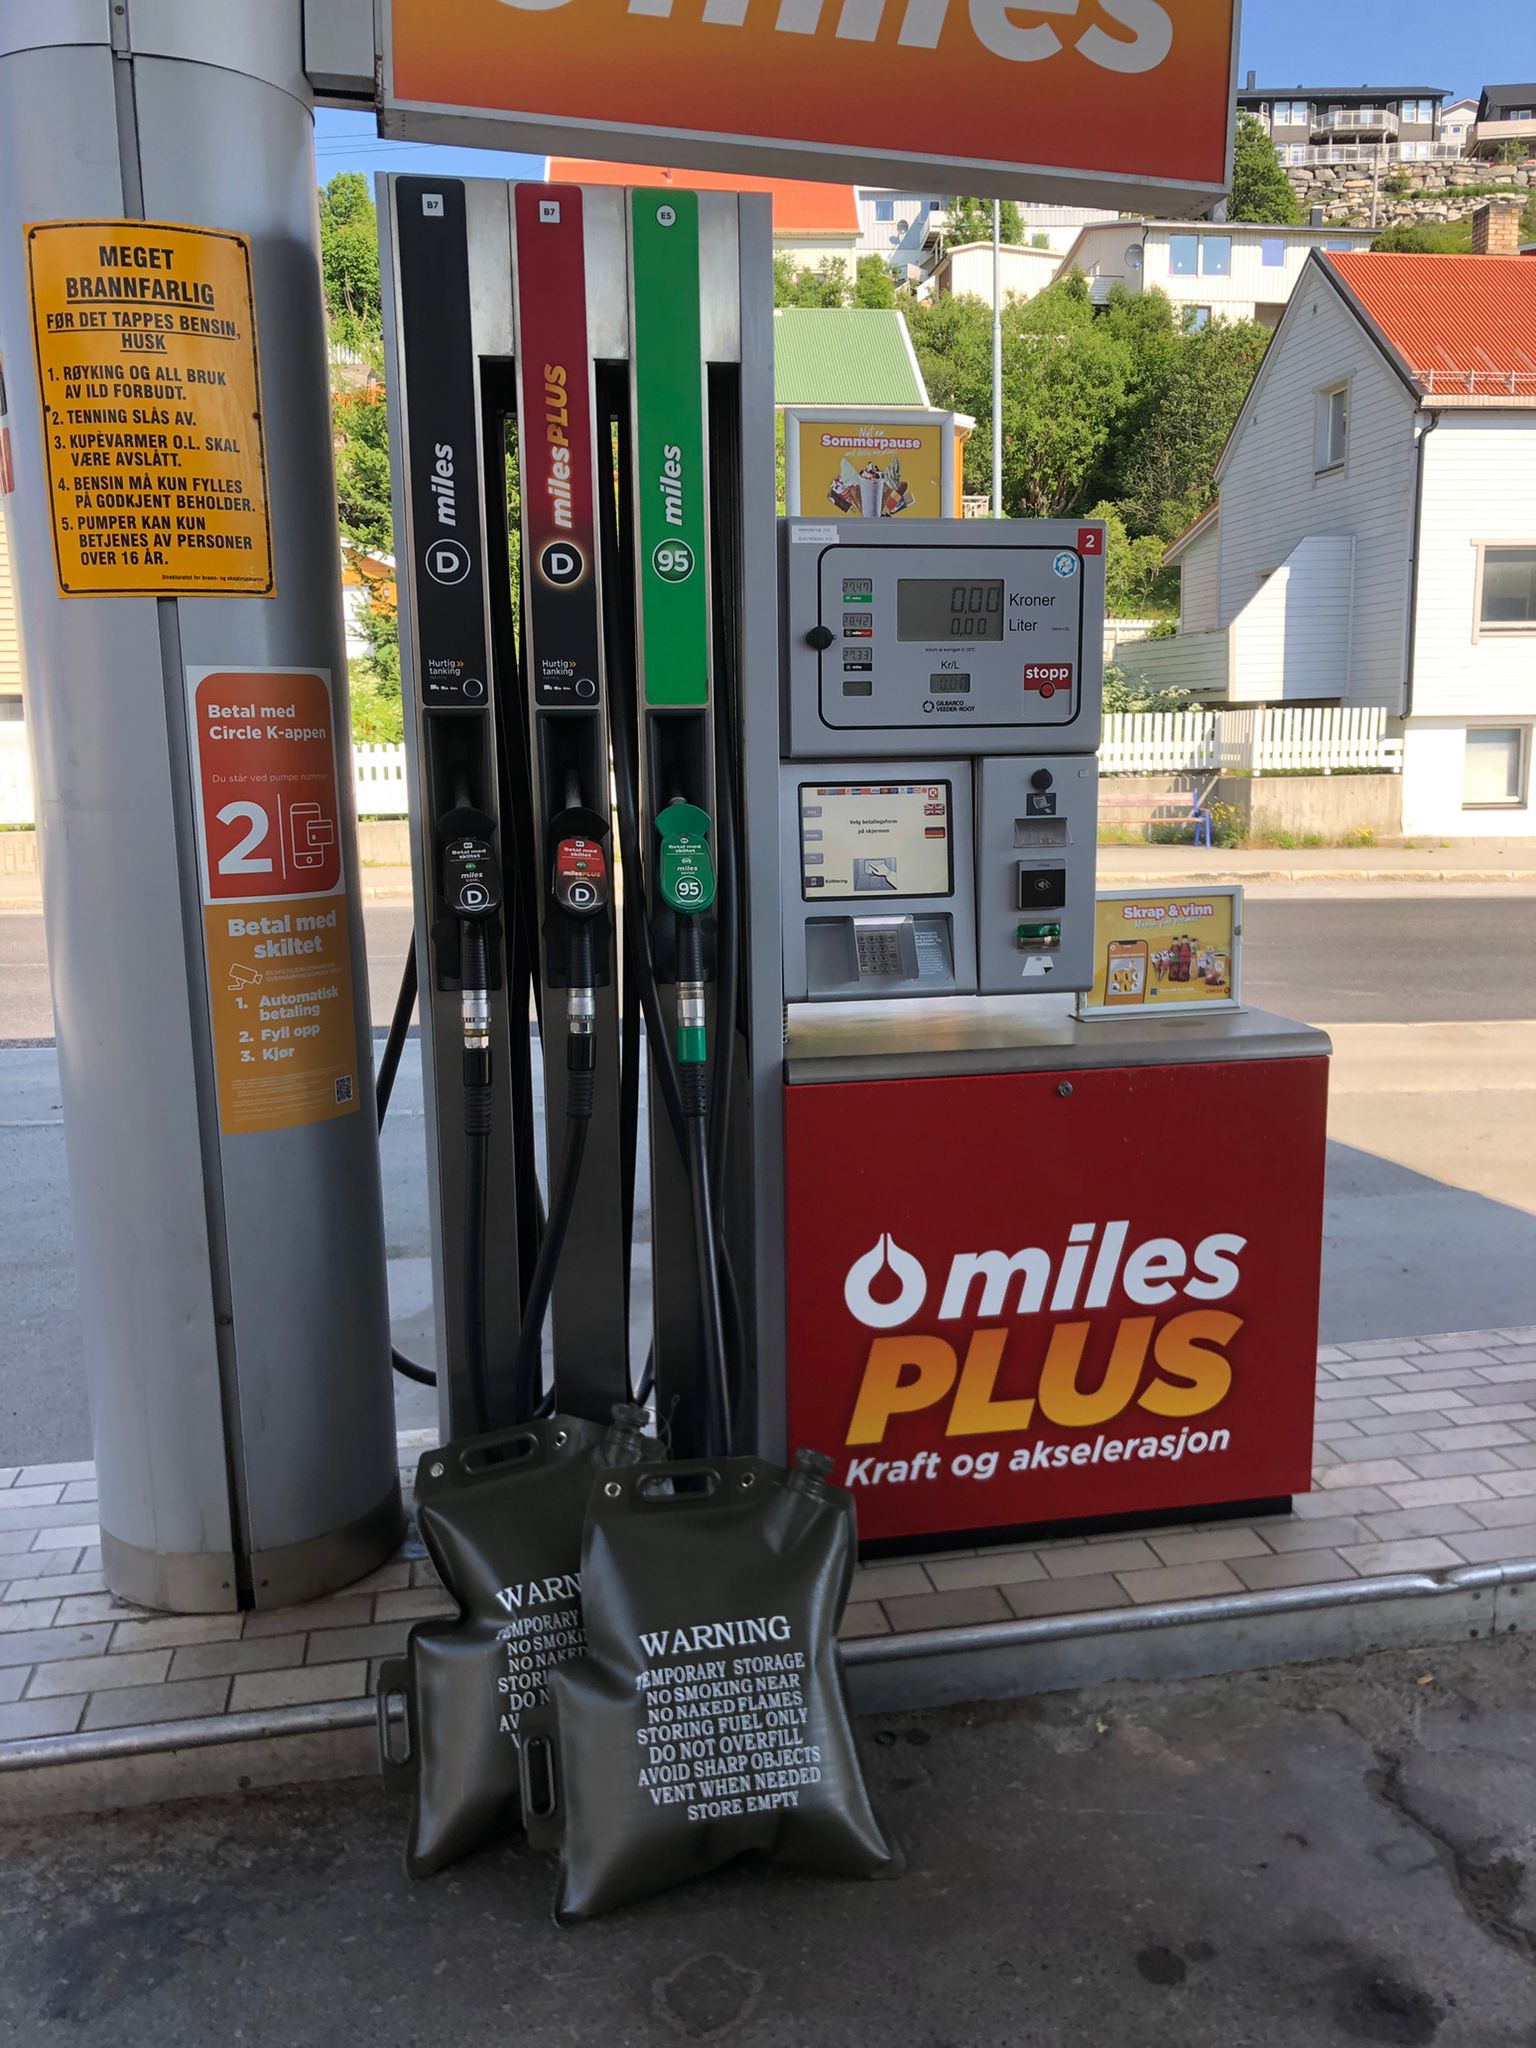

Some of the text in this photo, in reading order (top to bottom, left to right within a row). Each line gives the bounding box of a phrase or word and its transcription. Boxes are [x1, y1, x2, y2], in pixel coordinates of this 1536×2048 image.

[426, 200, 439, 209] B7
[543, 207, 555, 216] B7
[660, 211, 672, 220] E5
[99, 246, 174, 270] MEGET
[66, 277, 214, 305] BRANNFARLIG
[47, 312, 240, 339] FØR DET TAPPES BENSIN,
[121, 333, 166, 350] HUSK
[48, 365, 226, 385] 1. RØYKING OG ALL BRUK
[65, 384, 186, 400] AV ILD FORBUDT.
[52, 406, 196, 426] 2. TENNING SLÅS AV.
[54, 436, 65, 449] 3.
[173, 435, 200, 450] O.L.
[205, 437, 240, 453] SKAL
[822, 434, 921, 450] Sommerpause
[71, 449, 182, 467] VÆRE AVSLÅTT.
[58, 472, 243, 494] 4. BENSIN MÅ KUN FYLLES
[431, 443, 456, 527] miles
[660, 444, 682, 526] miles
[76, 492, 256, 512] PÅ GODKJENT BEHOLDER.
[61, 516, 205, 530] 5. PUMPER KAN KUN
[79, 534, 253, 550] BETJENES AV PERSONER
[1085, 534, 1095, 548] 2
[81, 548, 169, 565] OVER 16 ÅR.
[436, 551, 460, 573] D
[551, 553, 574, 575] D
[657, 549, 689, 572] 95
[951, 586, 1001, 614] 0,00
[1009, 593, 1056, 607] Kroner
[951, 618, 987, 637] 0,00
[1009, 619, 1038, 632] Liter
[429, 659, 455, 669] Hurtig
[429, 667, 460, 676] tanking
[542, 659, 568, 669] Hurtig
[543, 667, 574, 676] tanking
[941, 661, 960, 670] Kr/L
[1026, 666, 1069, 681] stopp
[208, 704, 295, 718] Betal med
[209, 725, 326, 741] Circle K-appen
[212, 774, 226, 783] Du
[229, 774, 248, 782] står
[250, 774, 267, 782] ved
[269, 774, 299, 783] pumpe
[216, 800, 273, 875] 2
[467, 890, 482, 904] D
[575, 888, 590, 902] D
[678, 882, 699, 896] 95
[1123, 903, 1213, 920] Skrap & vinn
[228, 910, 337, 937] Betal med
[254, 935, 323, 959] skiltet
[236, 986, 339, 1009] 1. Automatisk
[260, 1004, 320, 1021] betaling
[239, 1024, 320, 1043] 2. Fyll opp
[241, 1047, 295, 1063] 3. Kjør
[937, 1220, 1248, 1321] miles
[845, 1309, 1244, 1446] PLUS
[845, 1426, 1231, 1487] Kraft og akselerasjon
[496, 1572, 582, 1612] WARN
[507, 1629, 588, 1656] NO SMOKI
[639, 1615, 792, 1658] WARNING
[509, 1656, 534, 1673] NO
[635, 1652, 805, 1691] TEMPORARY STORAGE
[498, 1670, 549, 1694] STORI
[646, 1673, 801, 1706] NO SMOKING NEAR
[509, 1691, 536, 1711] DO
[648, 1690, 803, 1723] NO NAKED FLAMES
[637, 1708, 808, 1745] STORING FUEL ONLY
[649, 1728, 804, 1764] DO NOT OVERFILL
[638, 1746, 822, 1786] AVOID SHARP OBJECTS
[650, 1766, 822, 1805] VENT WHEN NEEDED
[687, 1790, 799, 1821] STORE EMPTY
